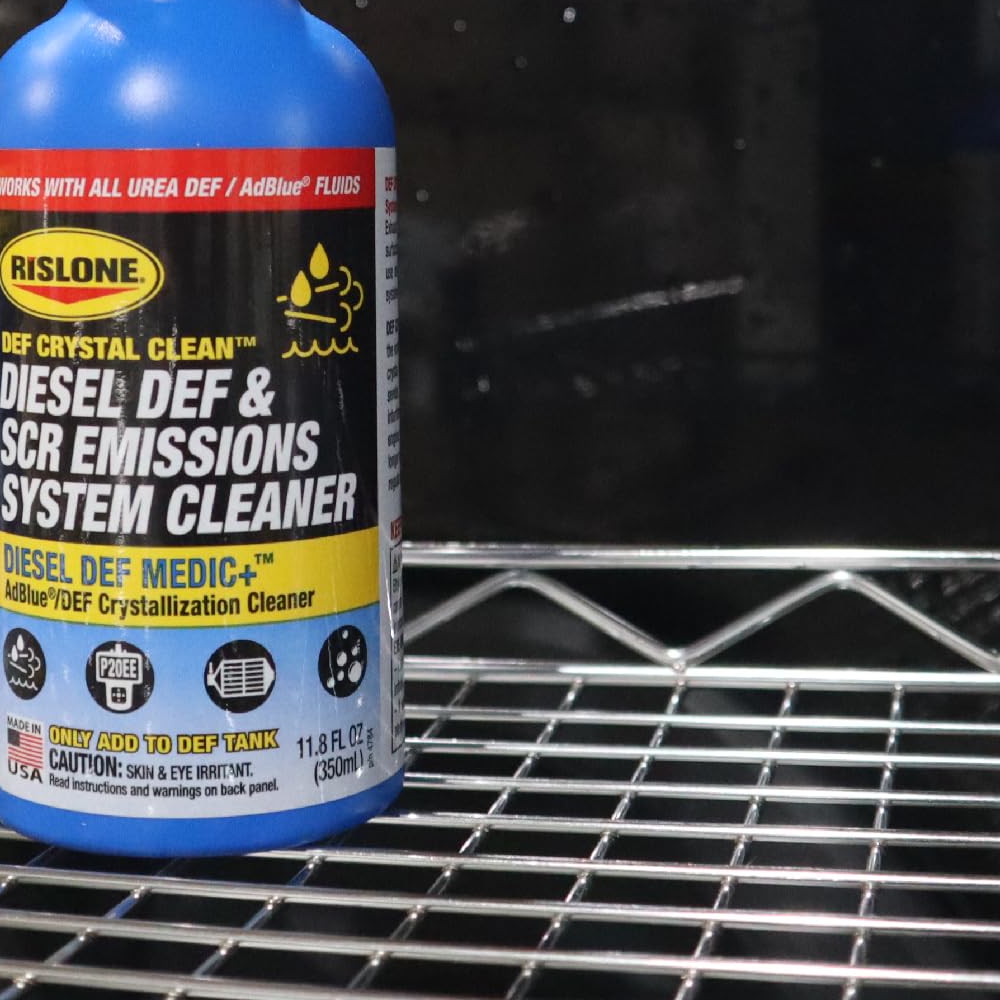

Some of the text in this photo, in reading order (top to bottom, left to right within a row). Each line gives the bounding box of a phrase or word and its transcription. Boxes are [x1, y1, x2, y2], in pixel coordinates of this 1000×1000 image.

[44, 177, 86, 198] WITH
[88, 177, 123, 197] ALL
[127, 177, 178, 197] UREA
[184, 177, 223, 197] DEF
[314, 175, 361, 196] FLUIDS
[1, 330, 31, 355] DEF
[36, 334, 141, 361] CRYSTAL
[0, 361, 275, 419] DIESEL DEF &
[0, 417, 321, 478] SCR EMISSIONS
[1, 472, 358, 536] SYSTEM CLEANER
[4, 543, 72, 584] DIESEL
[81, 555, 130, 587] DEF
[99, 593, 240, 620] Crystallization
[247, 589, 315, 613] Cleaner
[100, 657, 137, 680] P20EE
[7, 716, 42, 735] MADE IN
[49, 725, 280, 754] ONLY ADD TO DEF TANK
[297, 723, 364, 759] 11.8 FL OZ
[8, 760, 43, 784] USA
[50, 748, 253, 780] CAUTION: SKIN & EYE IRRITANT.
[314, 749, 364, 787] (350mL)
[50, 774, 279, 800] Read instructions and warnings on back panel.
